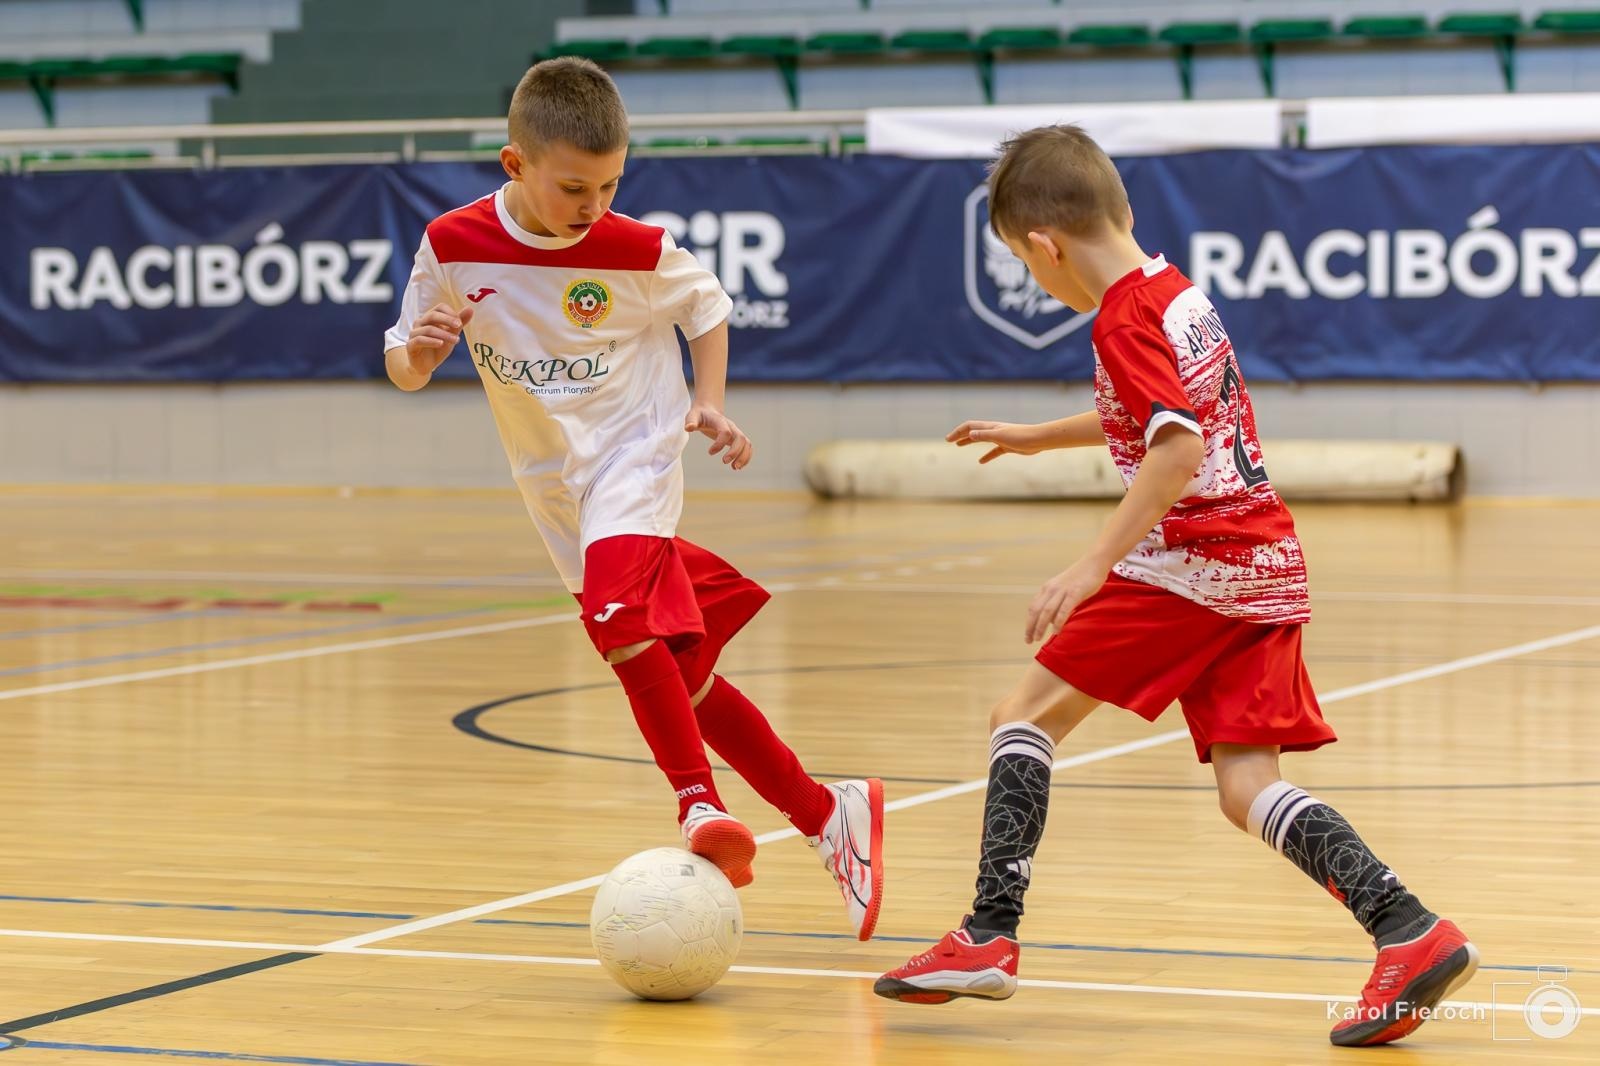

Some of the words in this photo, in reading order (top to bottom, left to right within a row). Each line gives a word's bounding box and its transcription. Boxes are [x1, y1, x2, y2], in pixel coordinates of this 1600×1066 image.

[30, 222, 393, 311] RACIBÓRZ
[1184, 323, 1207, 359] AP
[473, 343, 609, 387] REKPOL
[526, 386, 561, 395] Centrum
[1220, 354, 1269, 489] 2
[676, 783, 707, 799] oma
